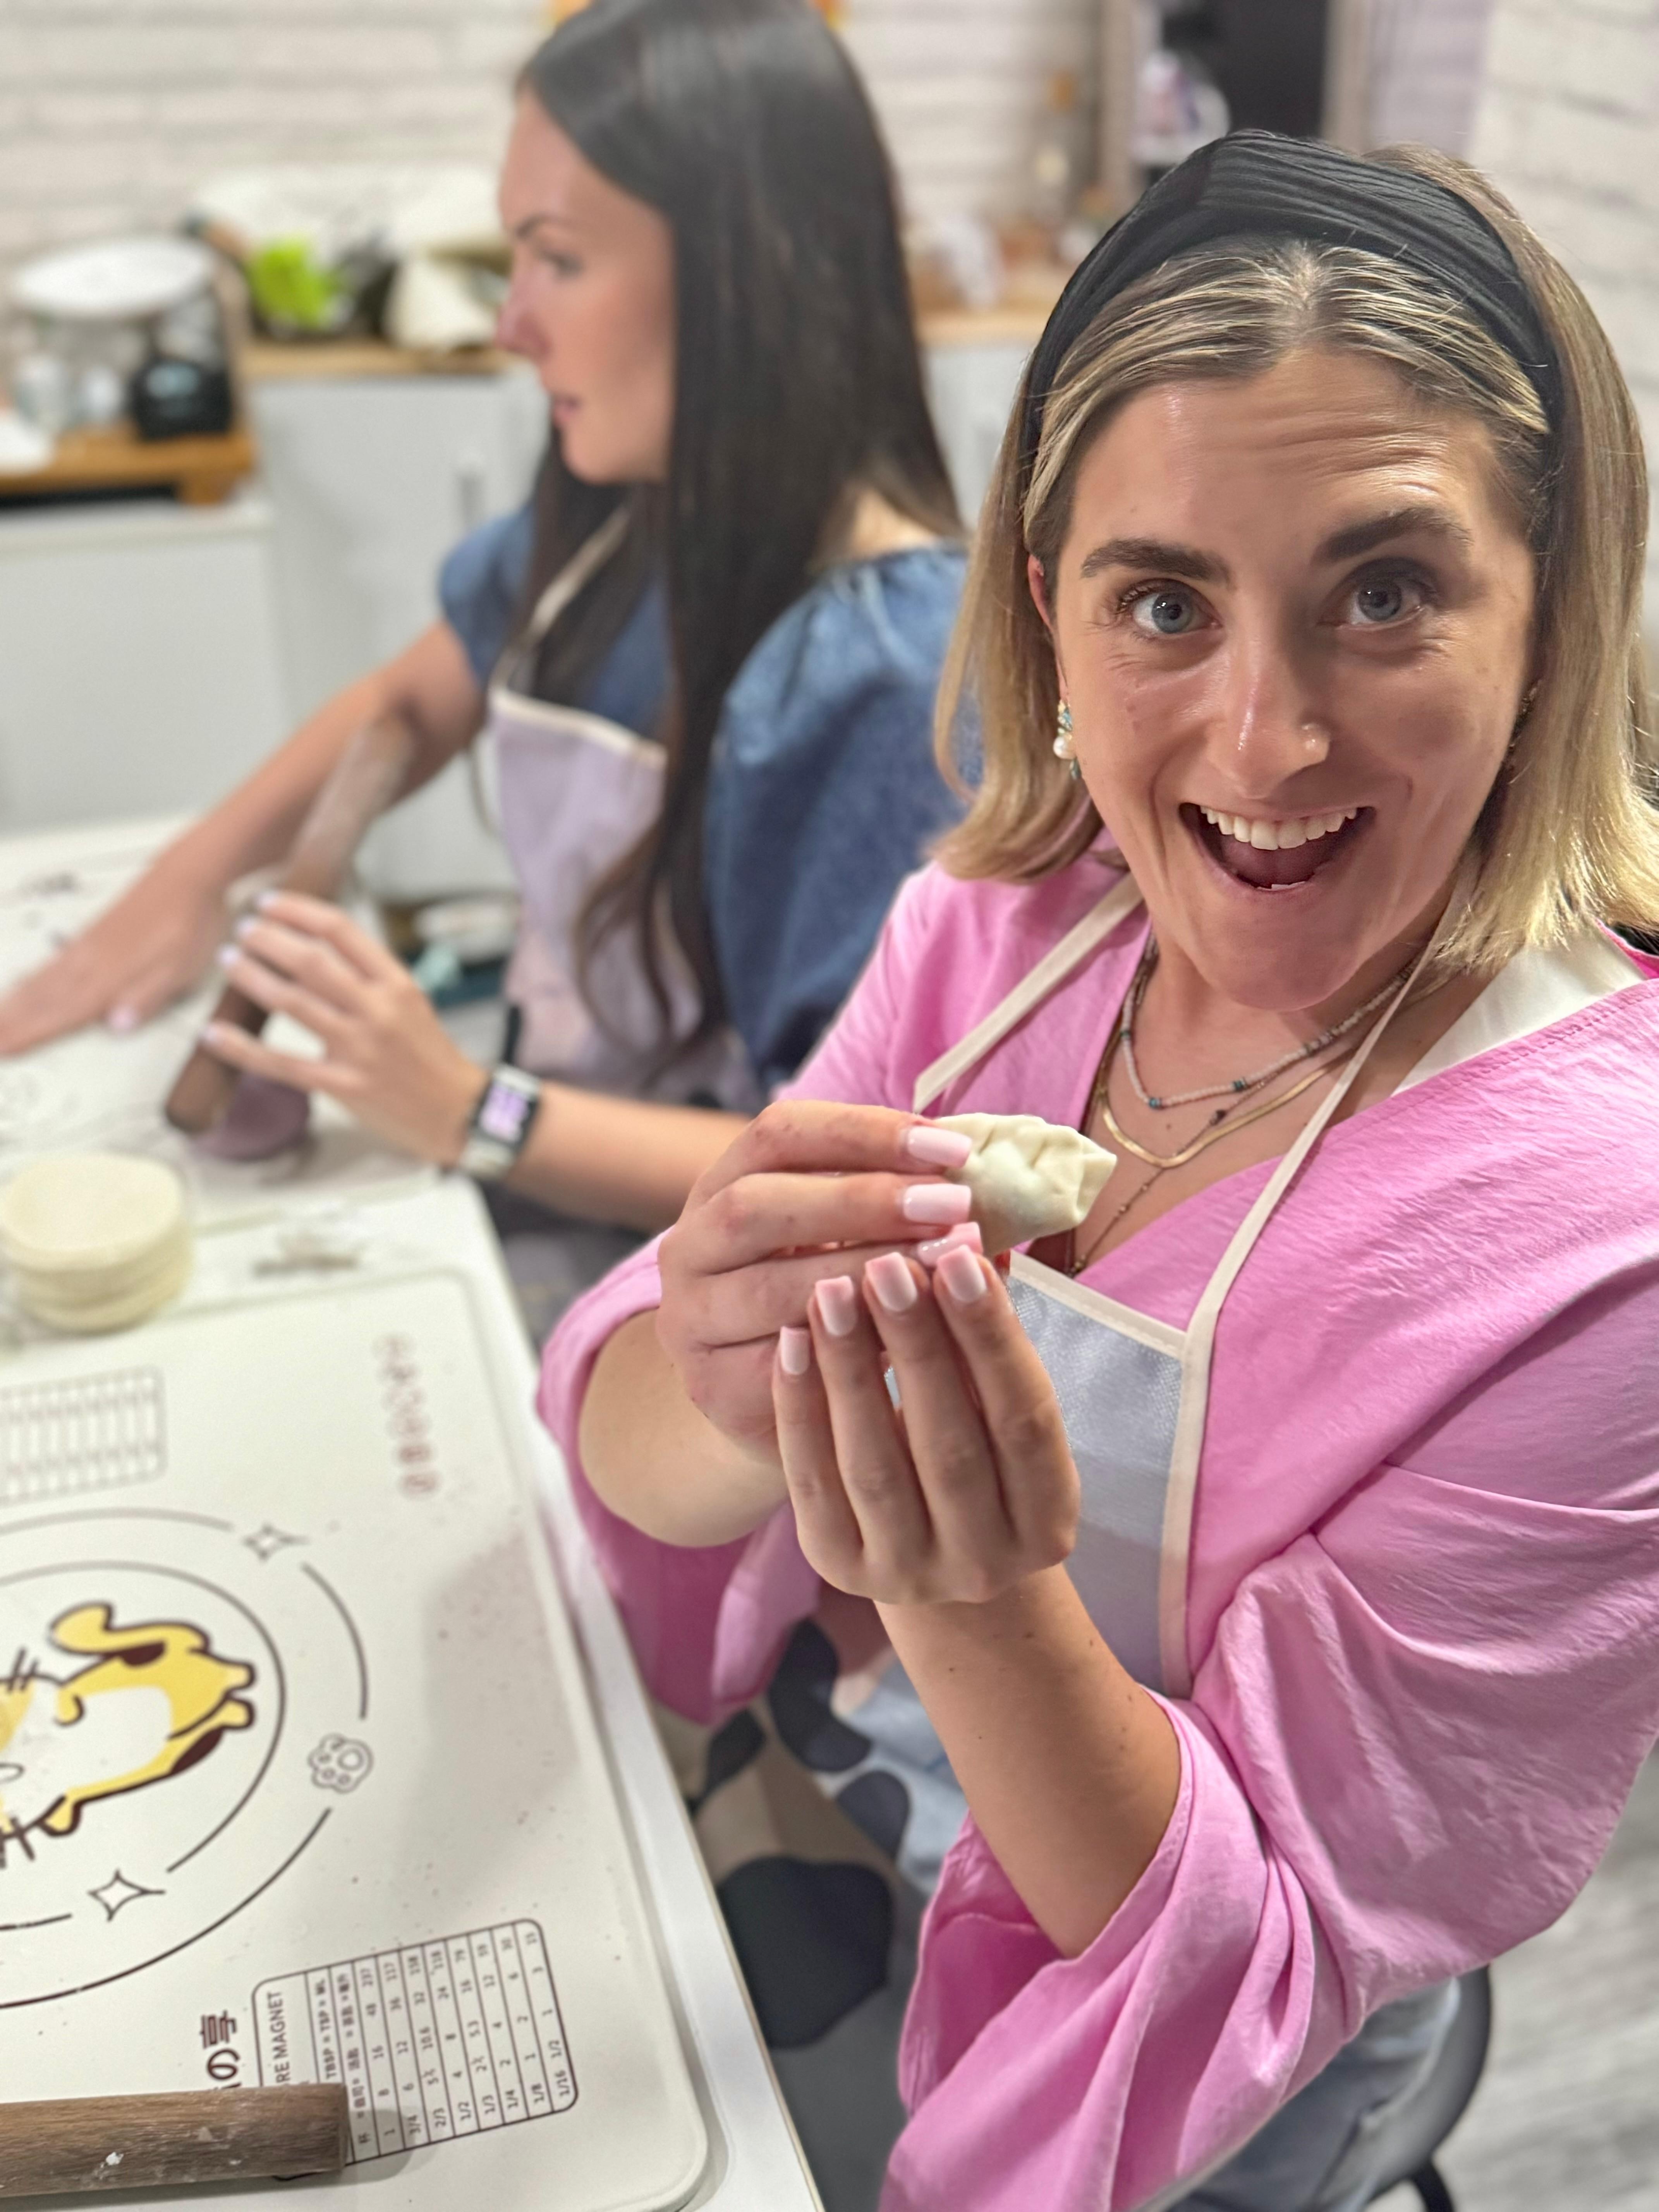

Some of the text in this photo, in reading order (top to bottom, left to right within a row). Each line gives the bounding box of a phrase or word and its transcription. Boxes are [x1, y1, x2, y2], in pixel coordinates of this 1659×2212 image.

[460, 1979, 472, 1993] 16
[482, 1974, 496, 1988] 12
[508, 1972, 519, 1980] 6
[318, 2010, 330, 2032] TSP
[541, 2008, 553, 2016] 1
[266, 1992, 290, 2085] RE MAGNET
[395, 2040, 409, 2055] 12
[419, 2026, 433, 2050] 10.6
[199, 2010, 241, 2089] の享
[371, 2045, 384, 2060] 16
[524, 2052, 536, 2061] 1
[548, 2039, 562, 2059] 1/2
[322, 2047, 337, 2080] TBSP
[499, 2059, 511, 2067] 2
[402, 2082, 414, 2091] 6
[530, 2083, 544, 2103] 1/8
[554, 2069, 570, 2097] 1/16
[481, 2094, 496, 2115] 1/3
[505, 2089, 519, 2109] 1/4
[432, 2107, 447, 2129] 2/3
[457, 2101, 472, 2121] 1/2
[383, 2128, 395, 2136] 1
[408, 2116, 421, 2137] 3/4
